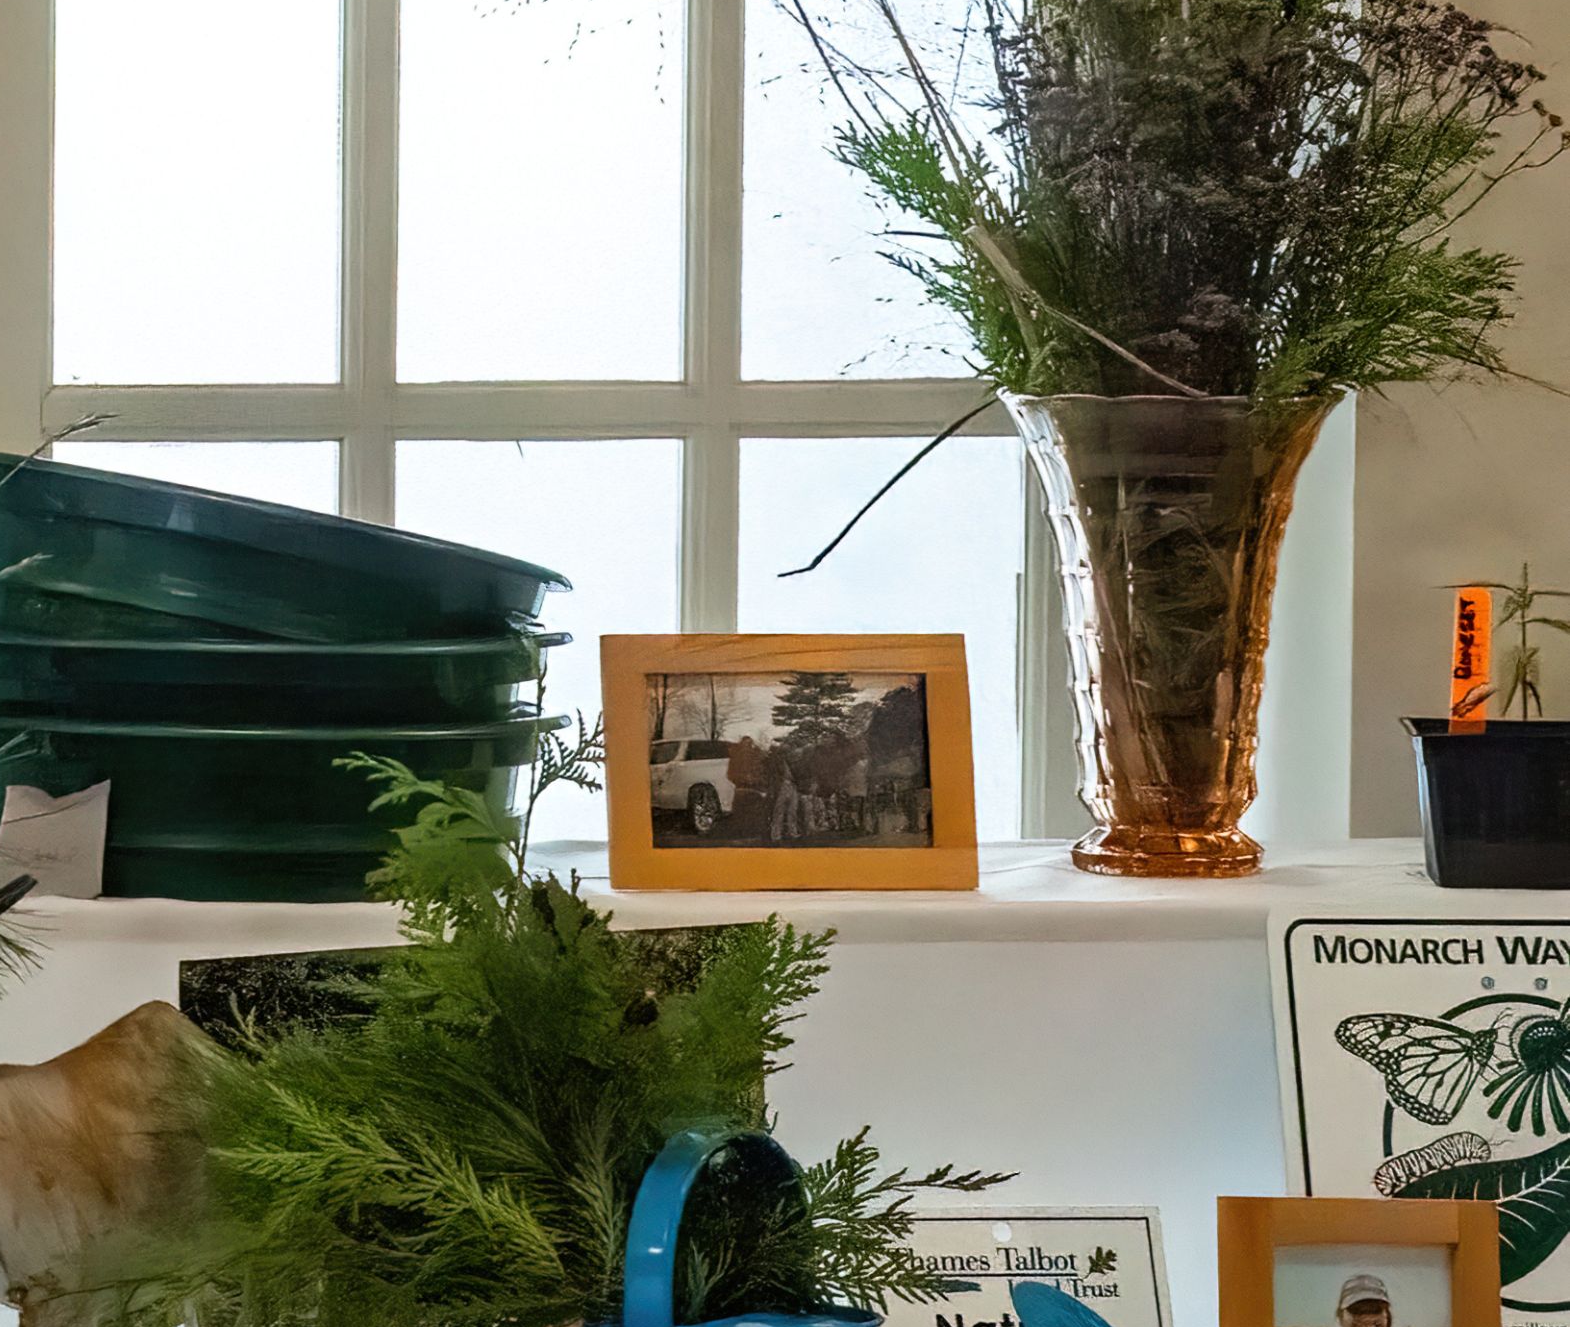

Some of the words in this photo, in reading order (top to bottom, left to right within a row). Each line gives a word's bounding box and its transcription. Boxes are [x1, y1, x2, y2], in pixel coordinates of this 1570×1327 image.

[1313, 934, 1485, 965] MONARCH
[996, 1247, 1078, 1272] Talbot
[1070, 1278, 1120, 1299] Trust
